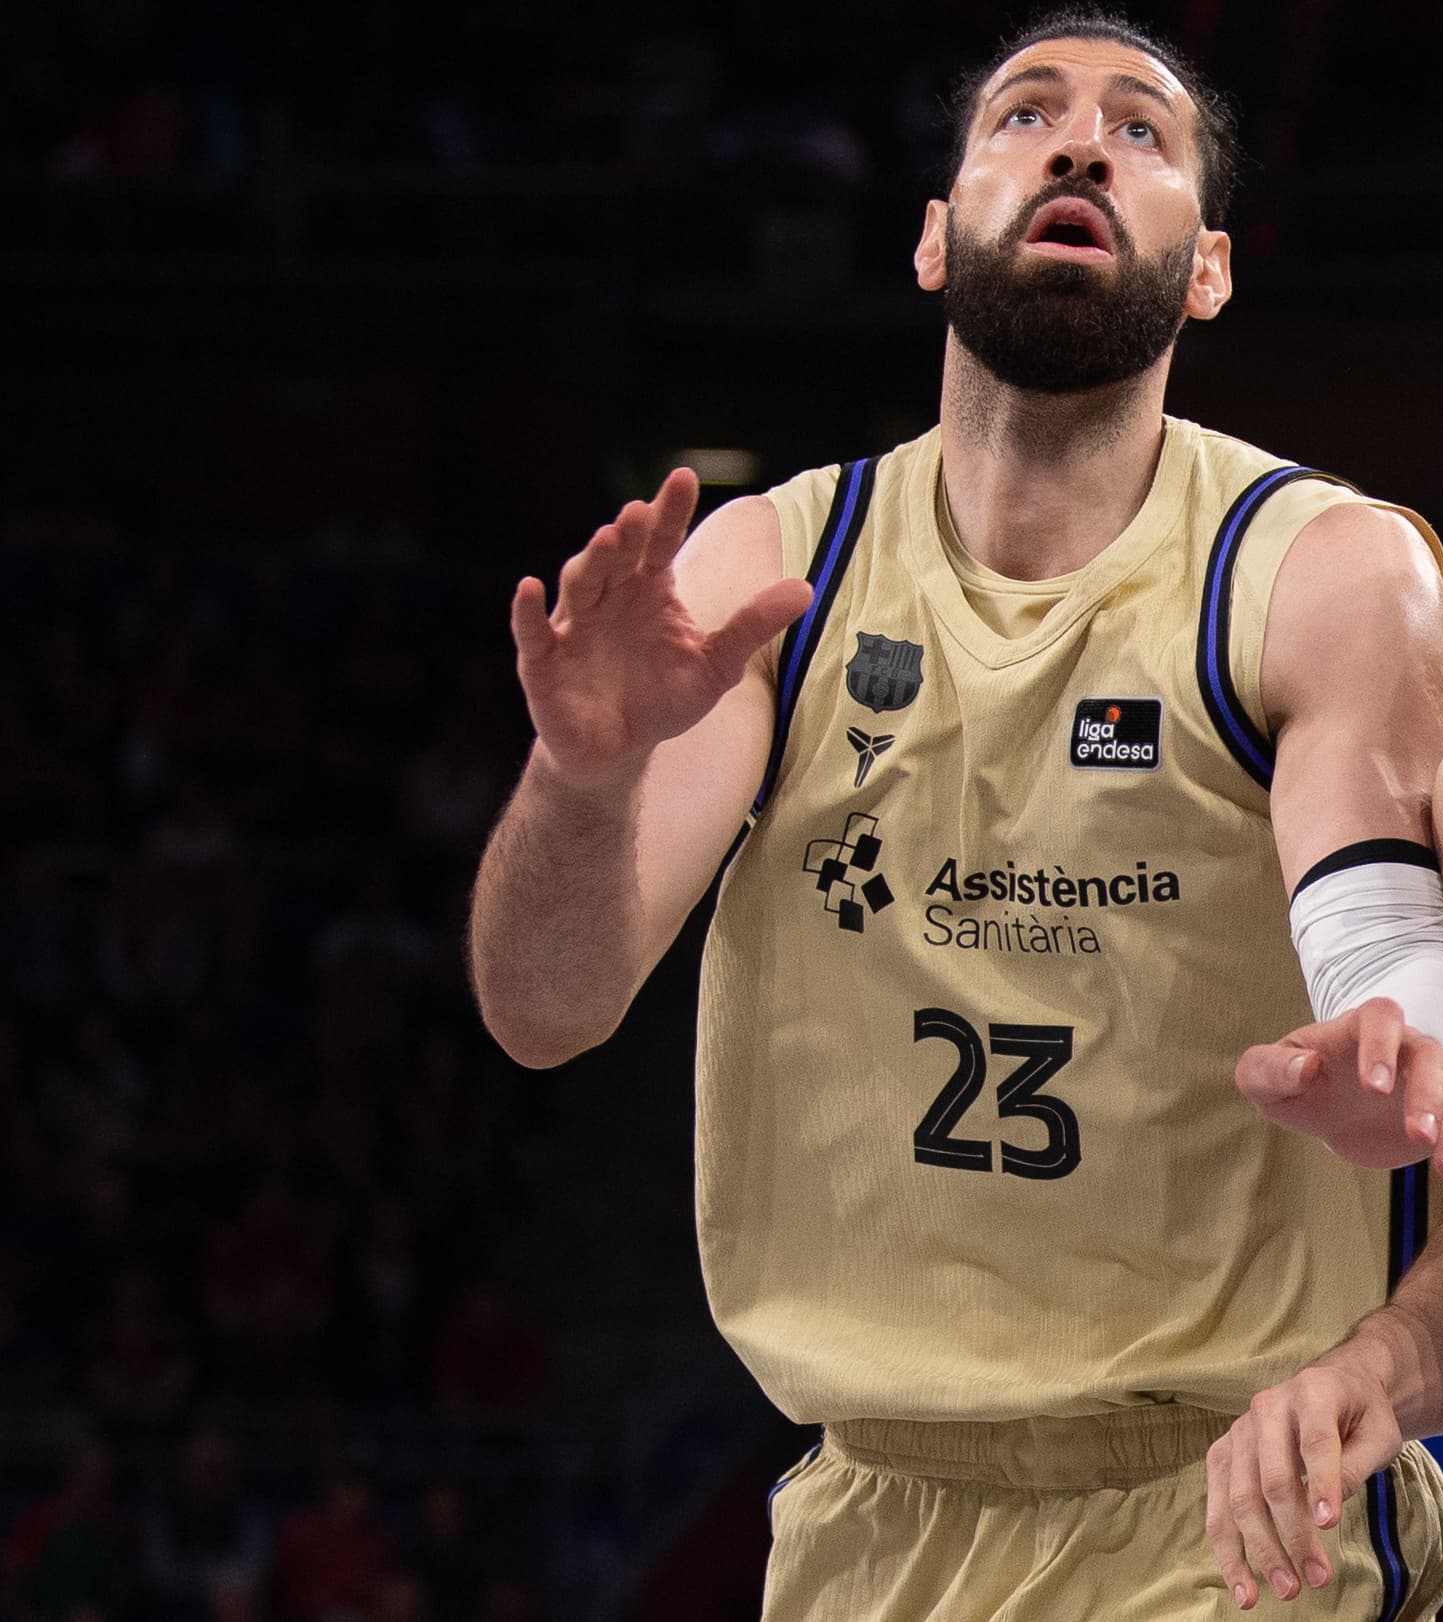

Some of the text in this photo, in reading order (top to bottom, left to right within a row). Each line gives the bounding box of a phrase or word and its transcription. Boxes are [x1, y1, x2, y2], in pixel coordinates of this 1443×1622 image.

[1077, 739, 1154, 760] endesa
[1078, 718, 1115, 741] liga
[925, 857, 1180, 907] Assistència
[923, 904, 1101, 954] Sanitària
[913, 1007, 1082, 1180] 23
